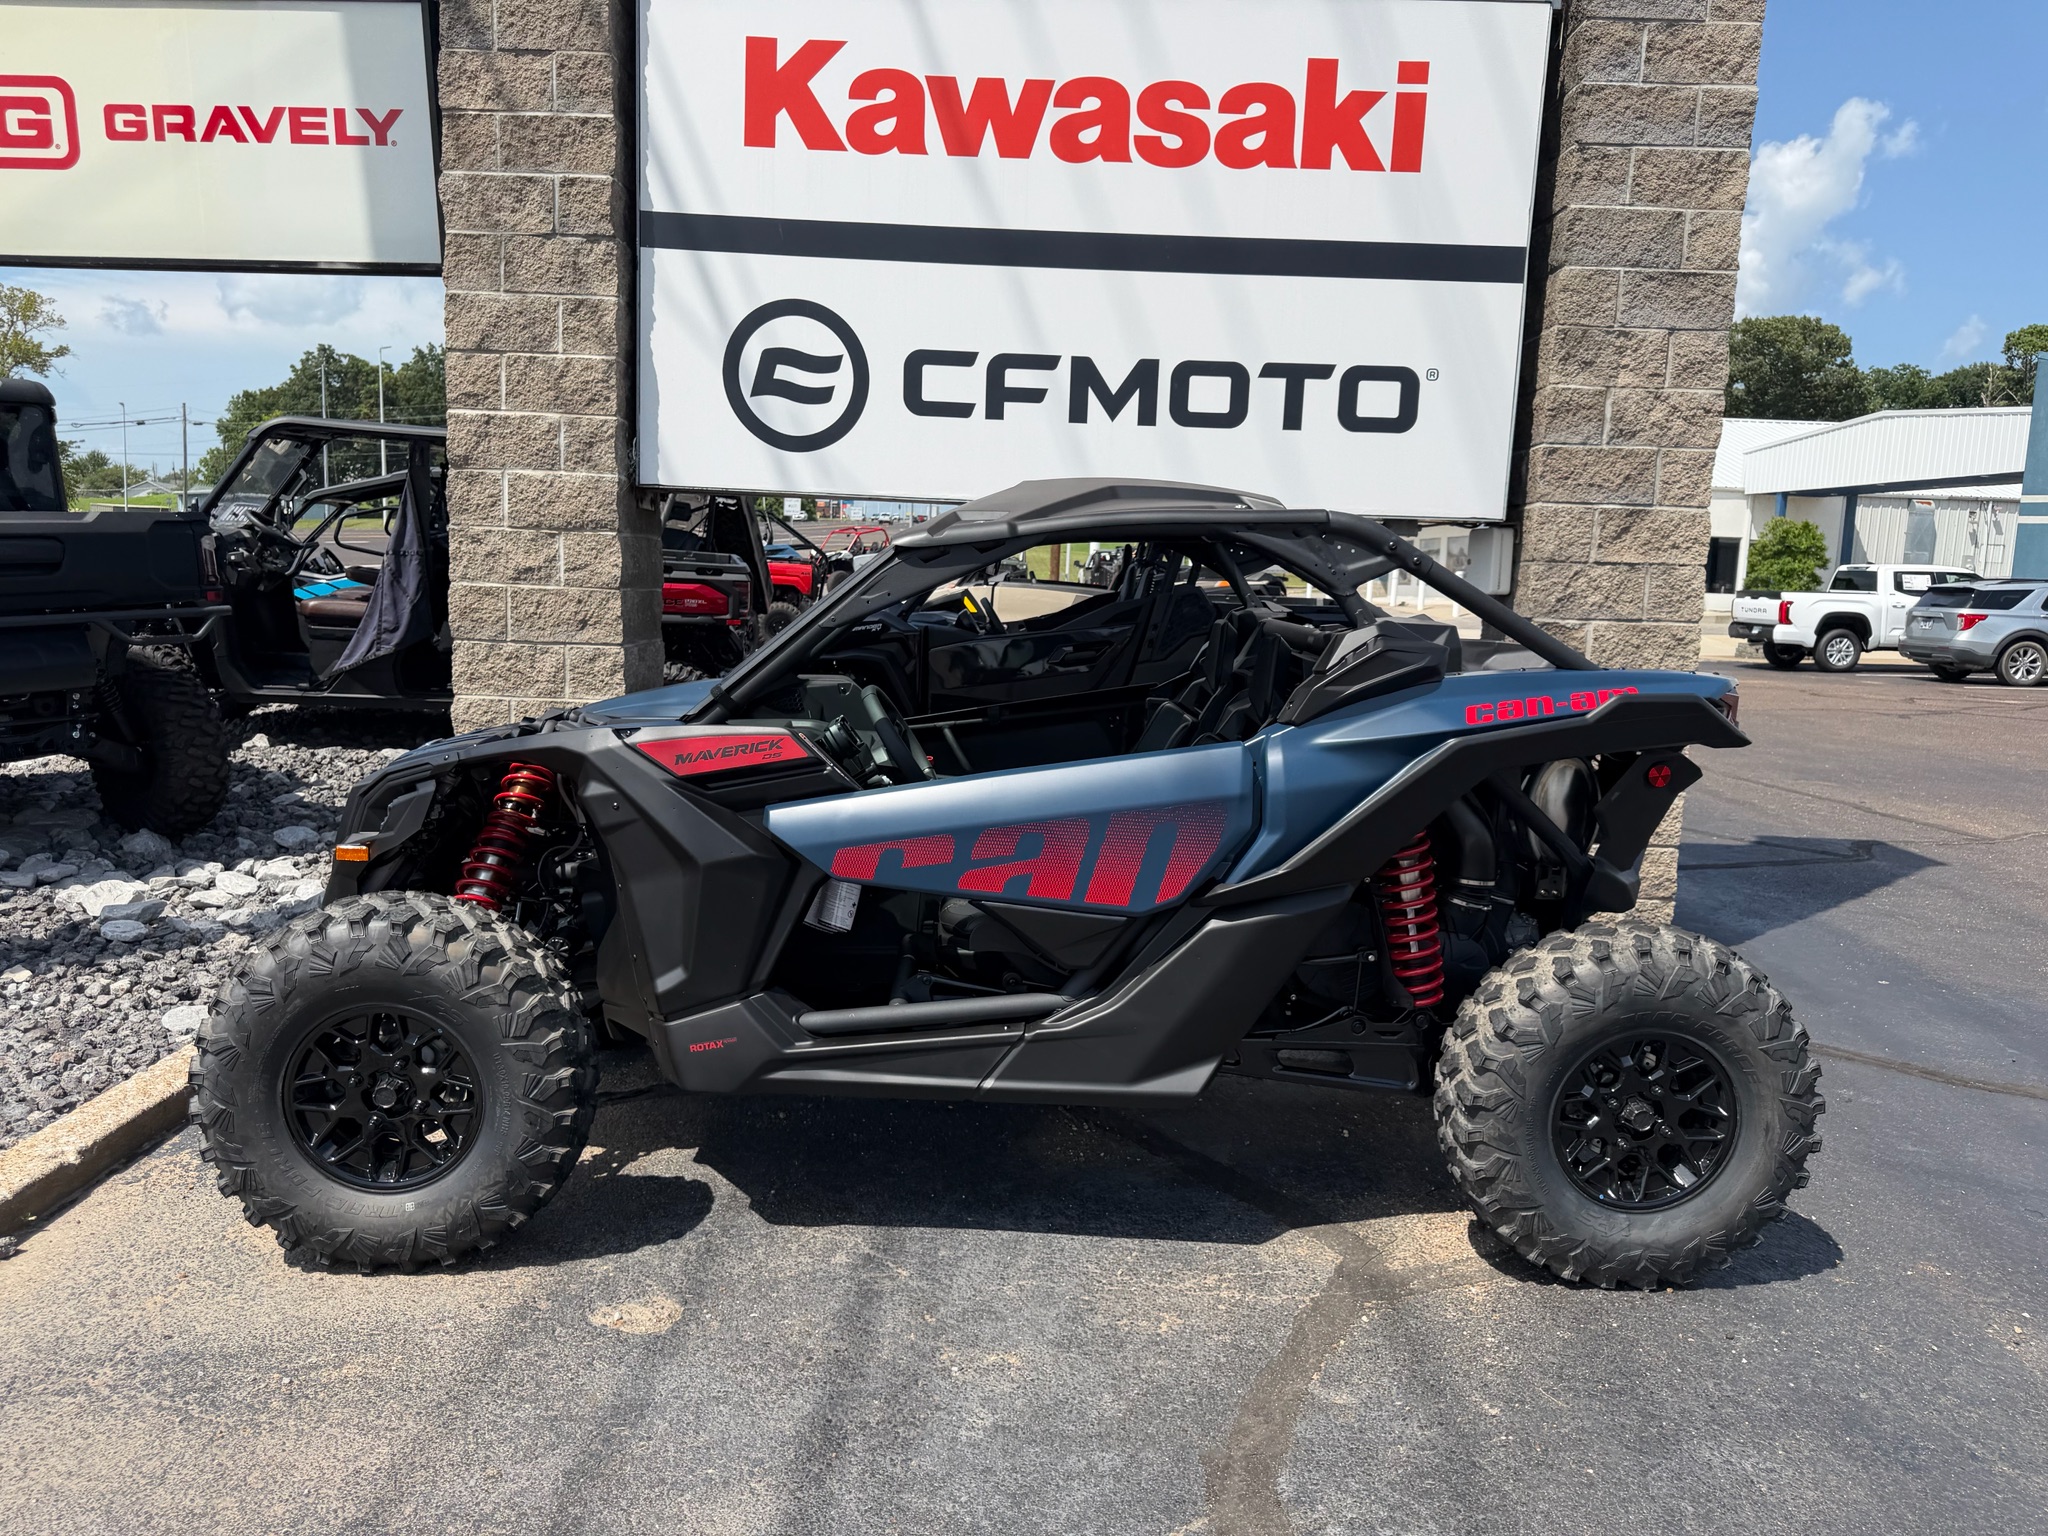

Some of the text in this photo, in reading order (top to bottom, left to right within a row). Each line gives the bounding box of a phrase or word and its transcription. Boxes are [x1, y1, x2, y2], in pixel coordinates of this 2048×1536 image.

[743, 36, 1430, 173] Kawasaki
[104, 104, 403, 146] GRAVELY
[903, 349, 1419, 434] CFMOTO
[675, 738, 785, 765] MAVERICK
[762, 752, 782, 760] DS
[690, 1040, 724, 1052] ROTAX
